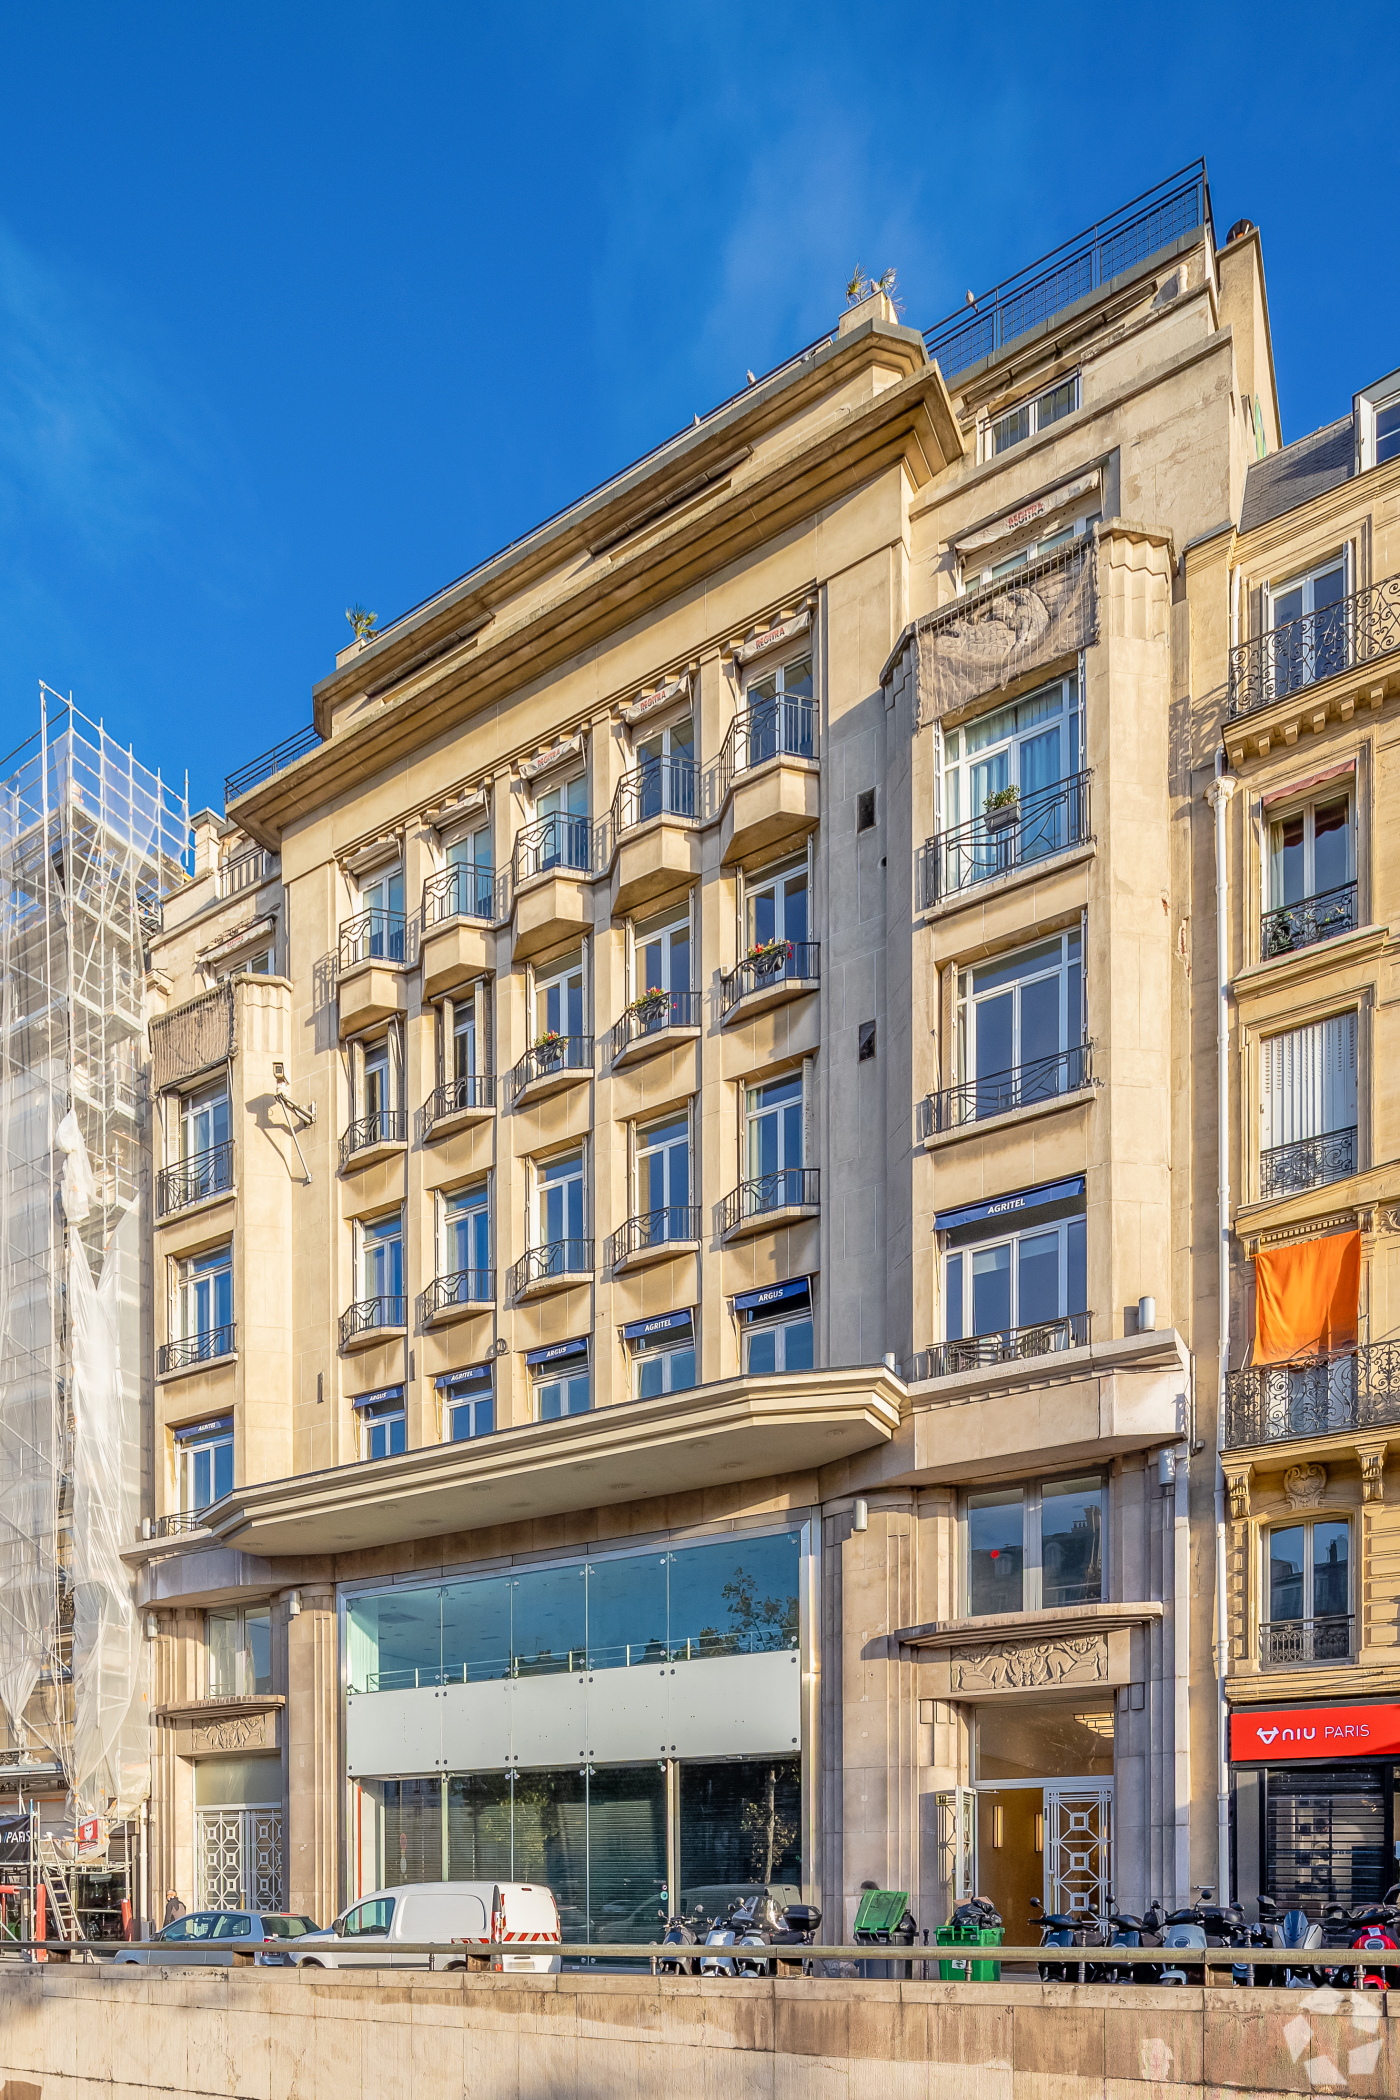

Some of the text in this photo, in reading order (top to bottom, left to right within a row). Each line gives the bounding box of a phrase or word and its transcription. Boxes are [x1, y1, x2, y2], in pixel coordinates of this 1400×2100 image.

[987, 1198, 1026, 1215] AGRITEL
[758, 1289, 784, 1302] ARGUS
[644, 1319, 672, 1332] AGRITEL
[546, 1347, 567, 1358] ARGUS
[450, 1370, 473, 1382] AGRITEL
[368, 1392, 387, 1402] ARGUS
[1324, 1724, 1370, 1738] PARIS
